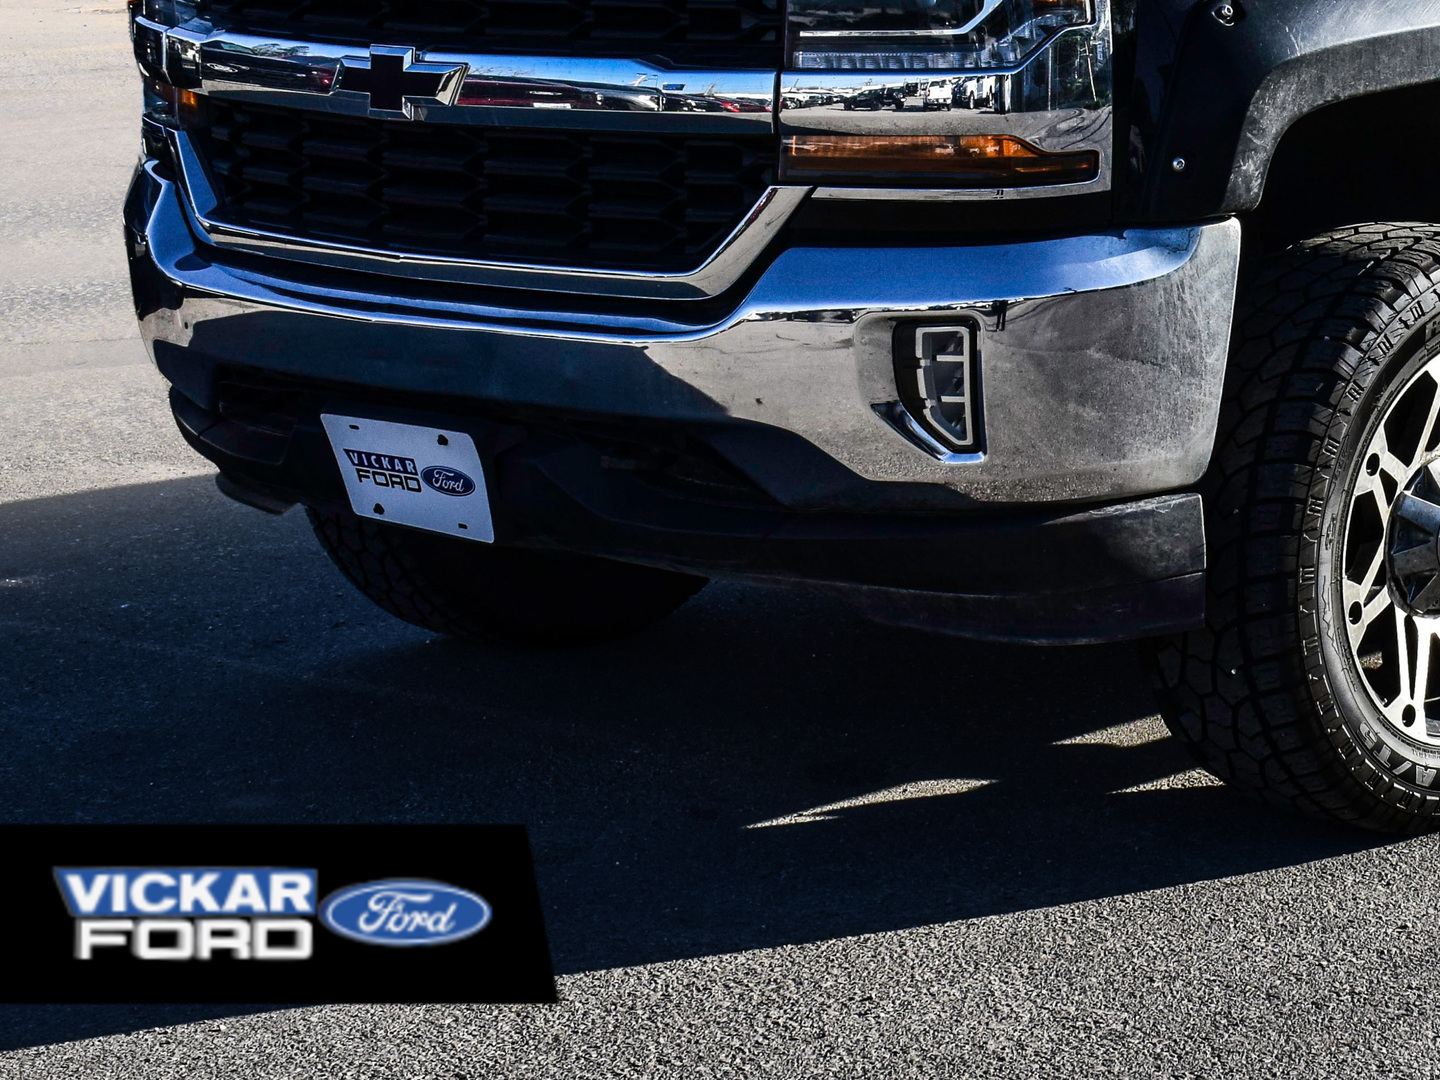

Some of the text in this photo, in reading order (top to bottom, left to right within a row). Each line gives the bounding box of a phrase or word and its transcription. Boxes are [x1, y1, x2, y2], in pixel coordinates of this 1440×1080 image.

[348, 450, 417, 475] VICKAR
[355, 467, 423, 493] FORD
[431, 469, 465, 493] Ford
